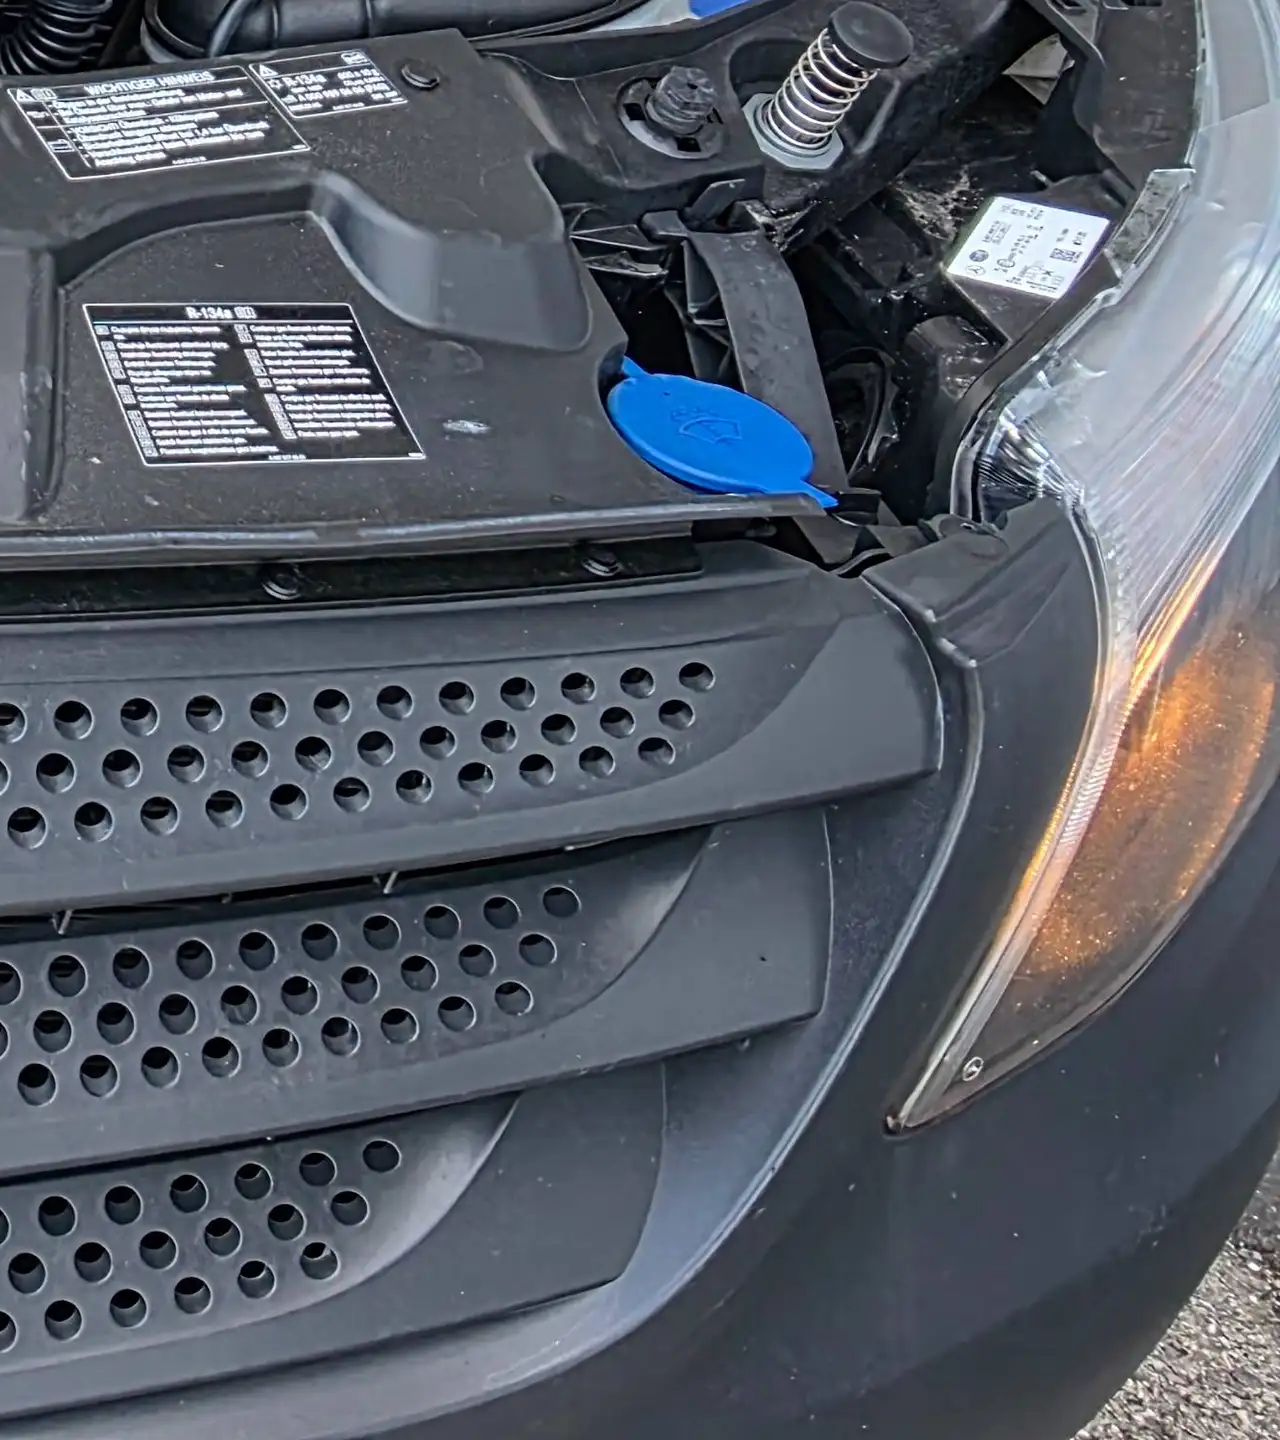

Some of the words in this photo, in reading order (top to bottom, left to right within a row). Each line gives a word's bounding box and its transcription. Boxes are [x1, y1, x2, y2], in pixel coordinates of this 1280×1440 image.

[83, 78, 160, 96] WICHTIGER
[157, 70, 215, 87] HINWEIS
[281, 73, 328, 86] R-134a
[186, 306, 233, 320] R-134a
